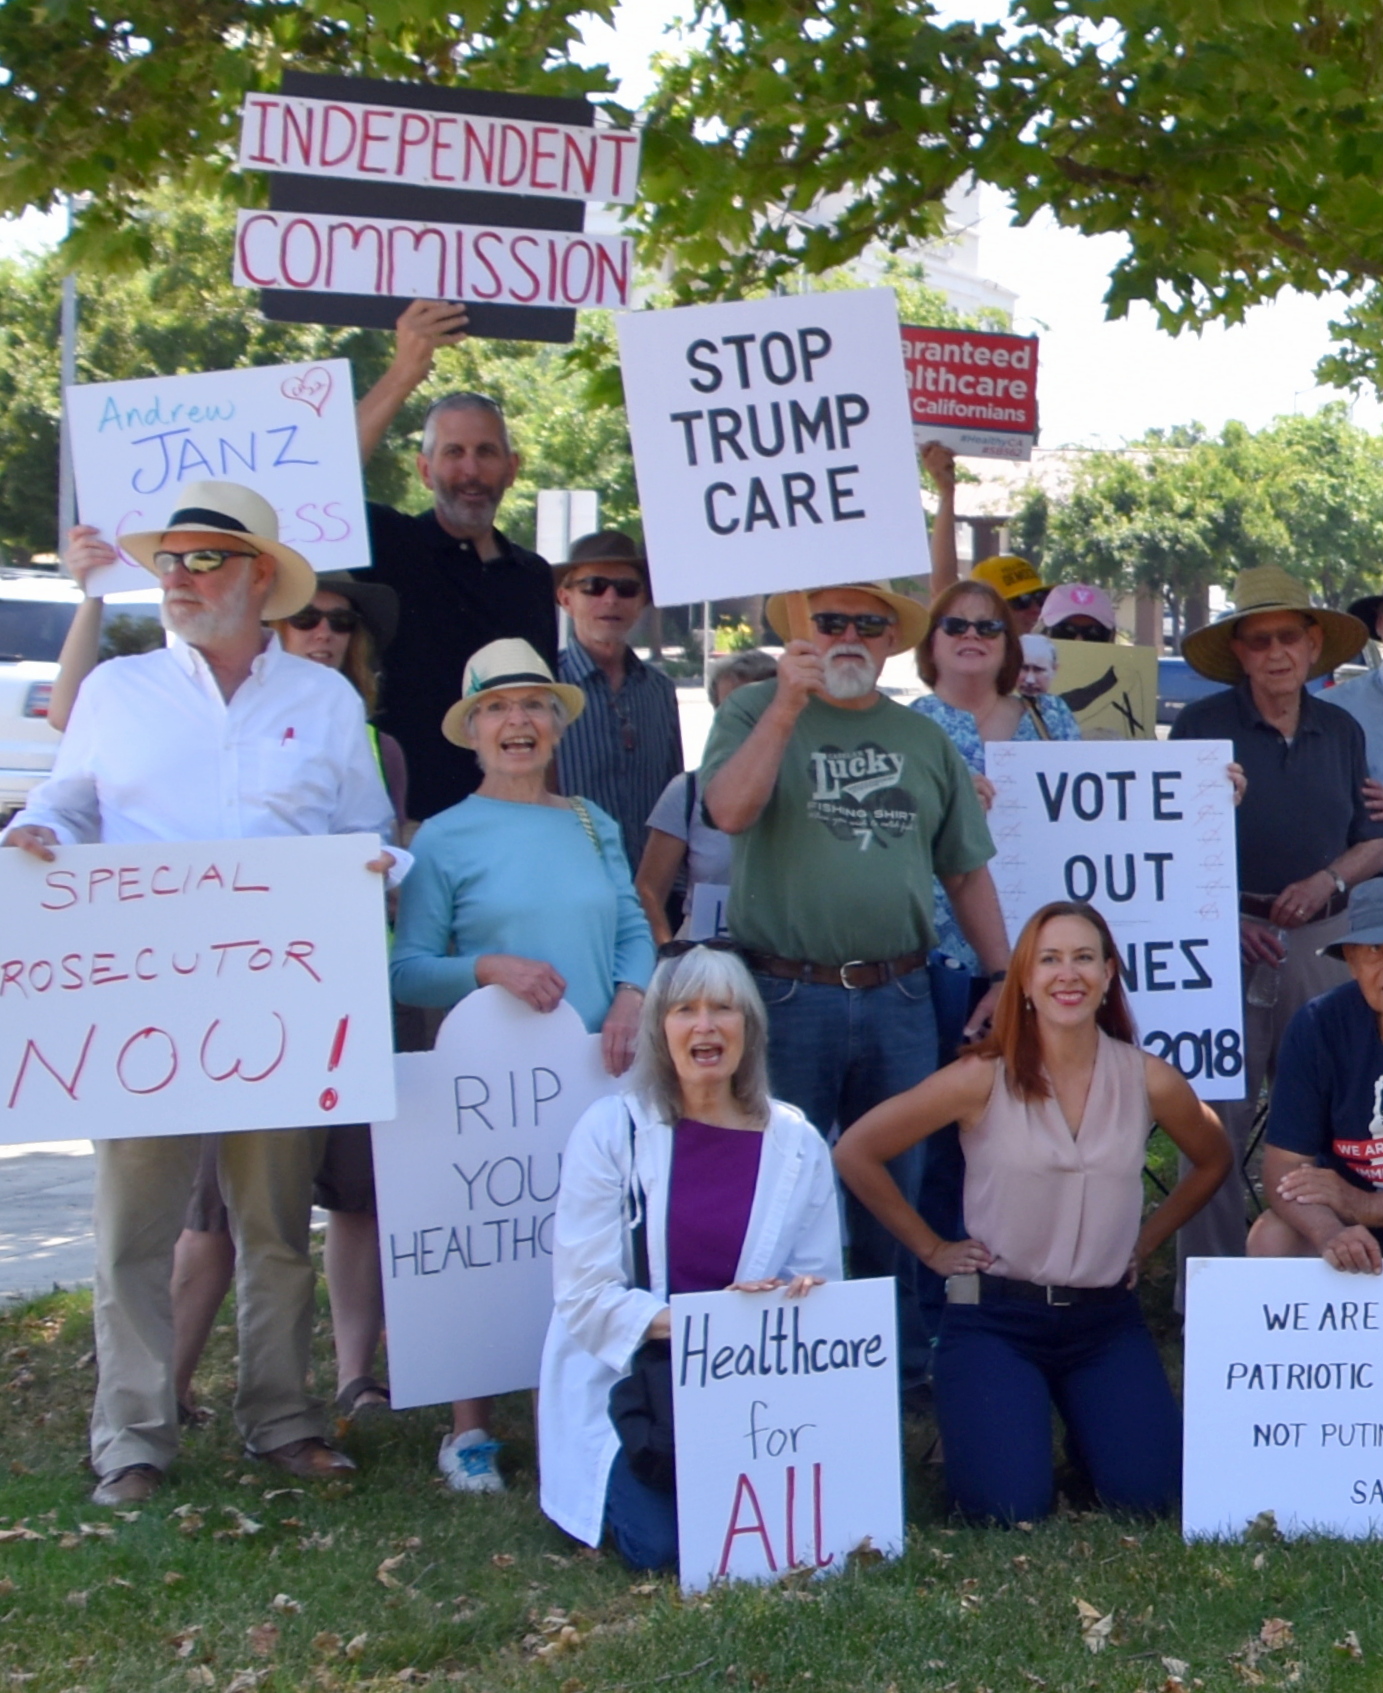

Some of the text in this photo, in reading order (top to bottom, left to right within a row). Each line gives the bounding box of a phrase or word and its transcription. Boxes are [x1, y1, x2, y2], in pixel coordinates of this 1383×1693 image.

[248, 100, 639, 197] INDEPENDENT
[238, 213, 629, 306] COMMISSION
[685, 327, 832, 394] STOP
[901, 340, 1031, 369] aranteed
[98, 396, 236, 432] Andrew
[670, 393, 870, 466] TRUMP
[913, 396, 1026, 422] Californians
[131, 425, 319, 494] JANZ
[704, 464, 866, 536] CARE
[811, 748, 904, 801] Lucky
[1036, 771, 1183, 822] VOTE
[807, 801, 917, 821] FISHING SHIRT
[853, 829, 872, 851] 7
[40, 863, 271, 910] SPECIAL
[1064, 853, 1173, 902] OUT
[0, 940, 322, 998] ROSECUTOR
[8, 1010, 350, 1112] NOW!
[1143, 1029, 1243, 1080] 2018
[454, 1067, 561, 1135] RIP
[1337, 1144, 1360, 1156] WE
[453, 1152, 562, 1210] YOU
[389, 1216, 554, 1278] HEALTHC
[1262, 1302, 1309, 1332] WE
[1317, 1301, 1380, 1332] ARE
[680, 1305, 887, 1387] Healthcare
[1226, 1361, 1374, 1390] PATRIOTIC
[743, 1401, 817, 1459] for
[1252, 1422, 1308, 1448] NOT
[719, 1462, 834, 1576] All
